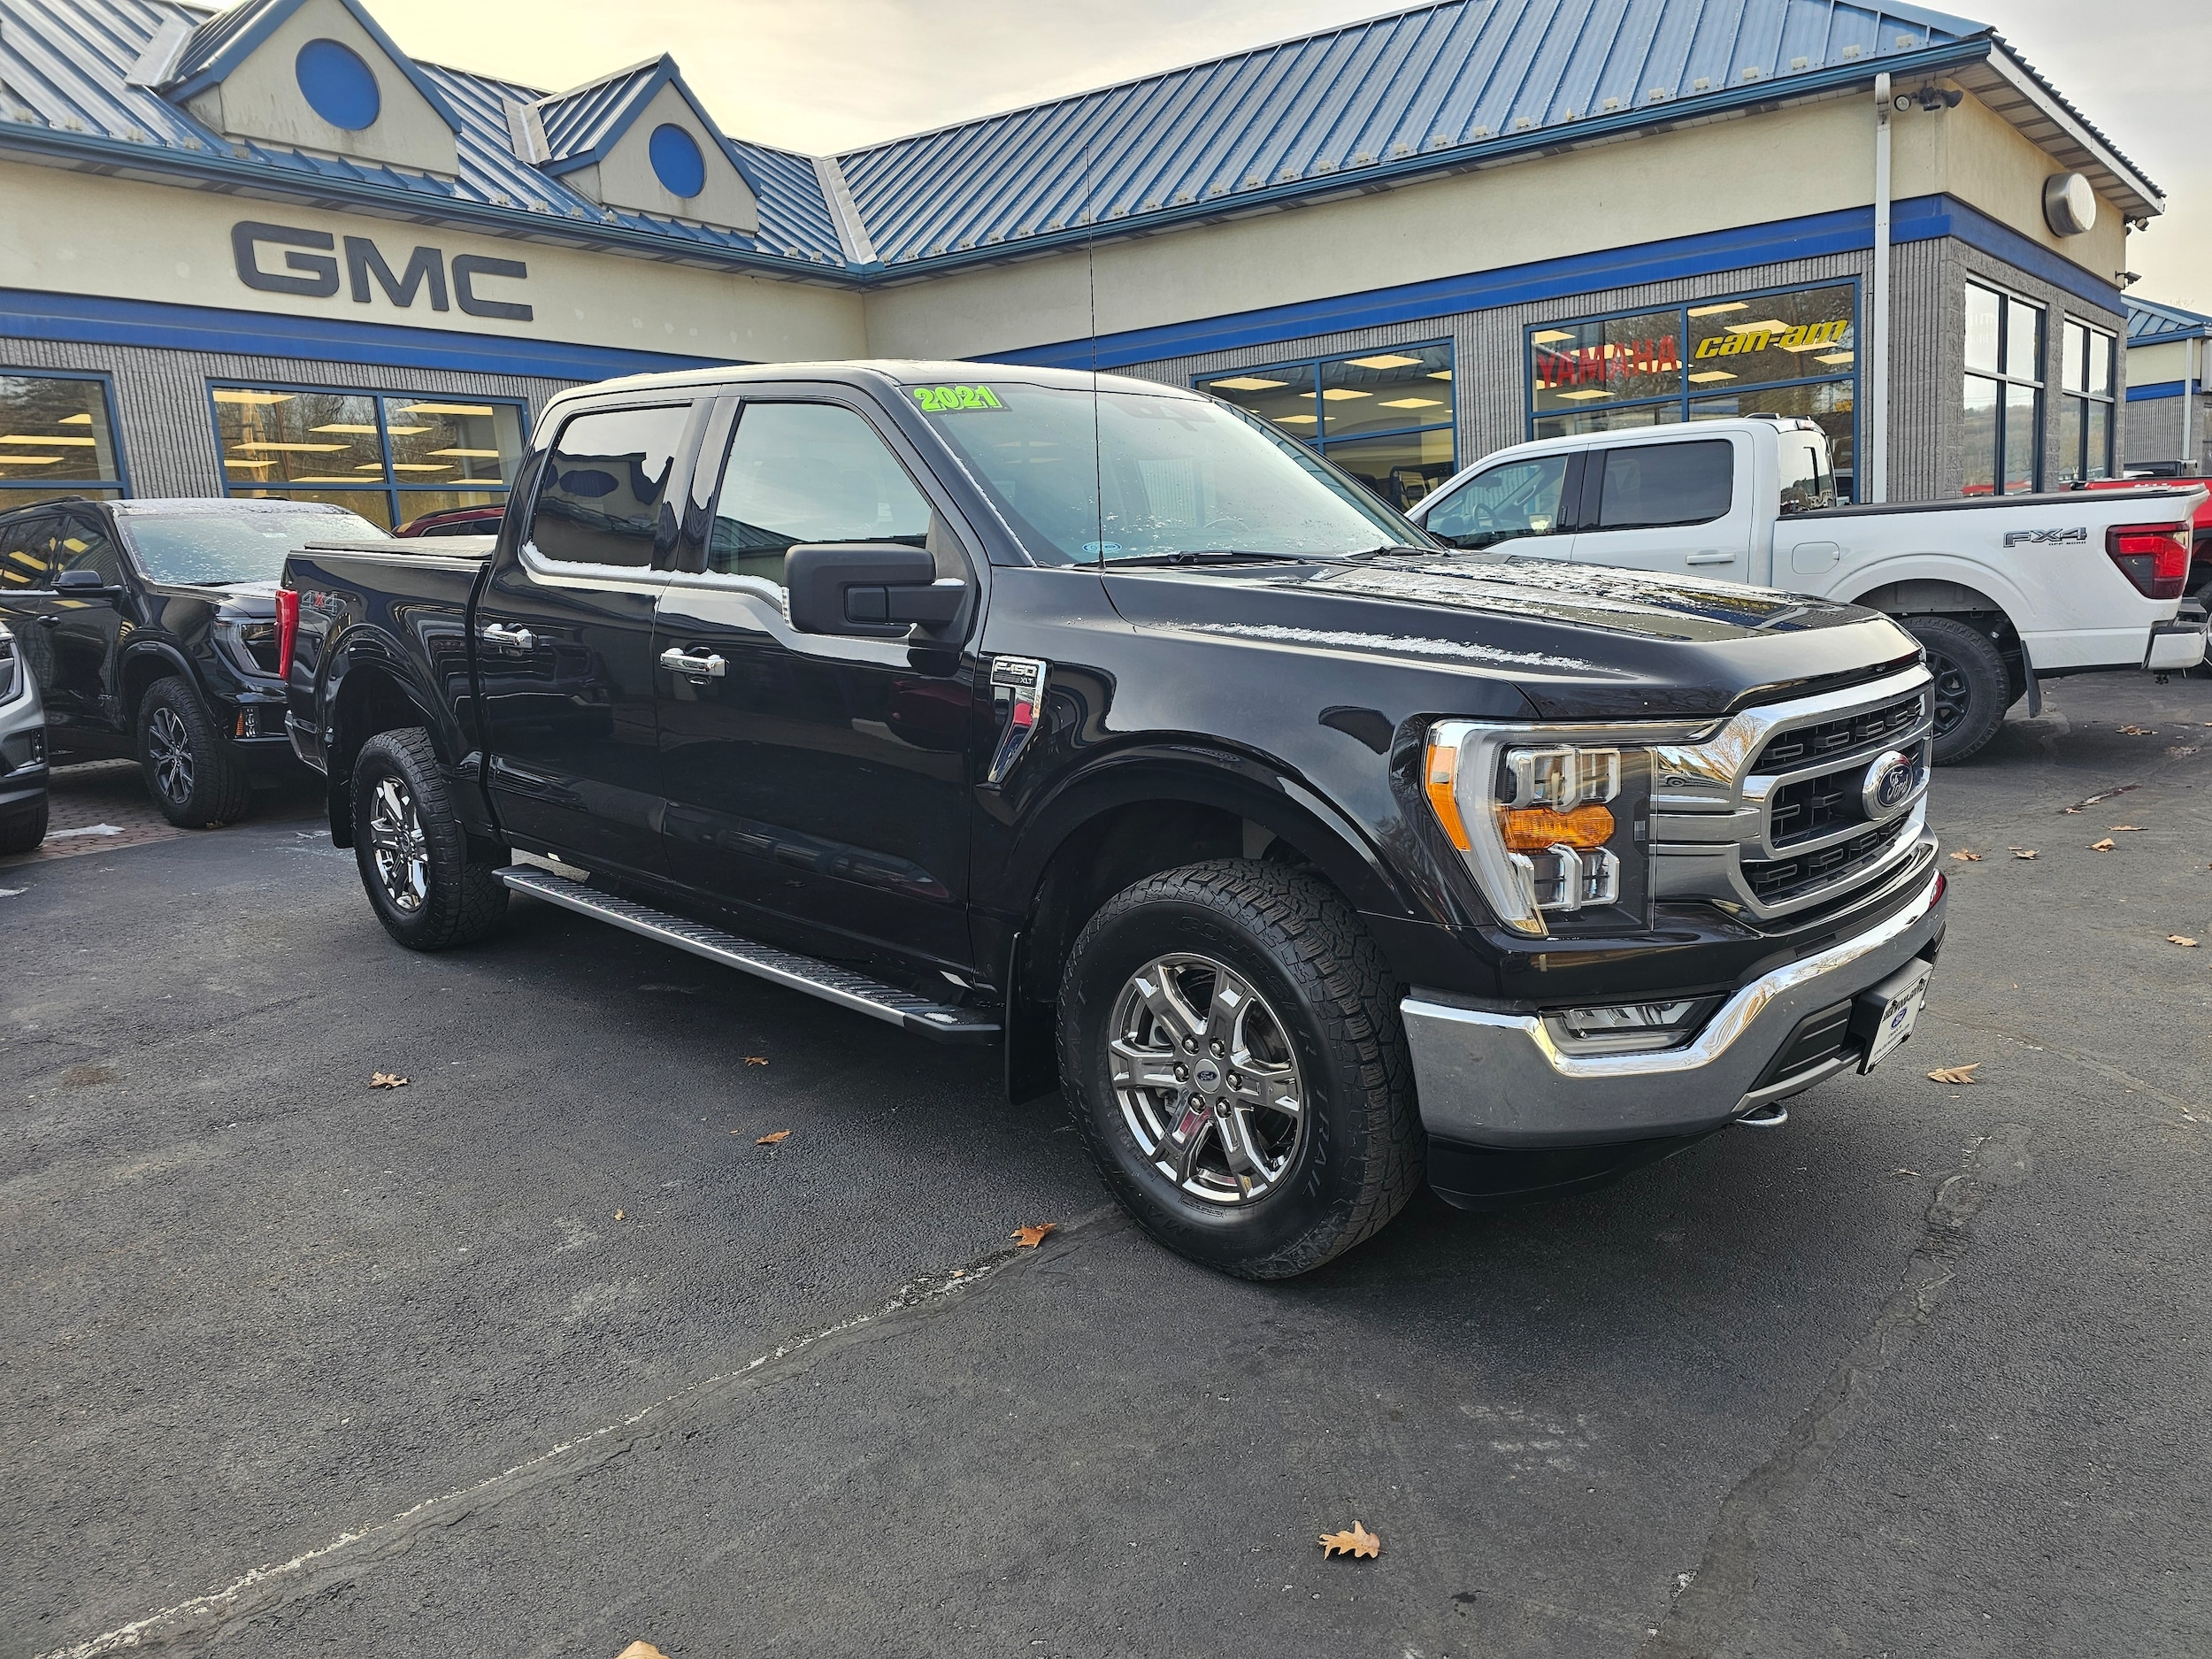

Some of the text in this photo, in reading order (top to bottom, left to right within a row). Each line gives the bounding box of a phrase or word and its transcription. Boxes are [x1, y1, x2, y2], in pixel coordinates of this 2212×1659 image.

[231, 220, 534, 321] GMC
[1694, 319, 1848, 360] can-am
[1537, 334, 1679, 389] YAMAHA
[913, 385, 1002, 411] 2021
[2002, 526, 2087, 548] FX4
[994, 661, 1038, 678] F-150
[1019, 676, 1034, 685] XLT
[1301, 1087, 1333, 1200] TRAIL
